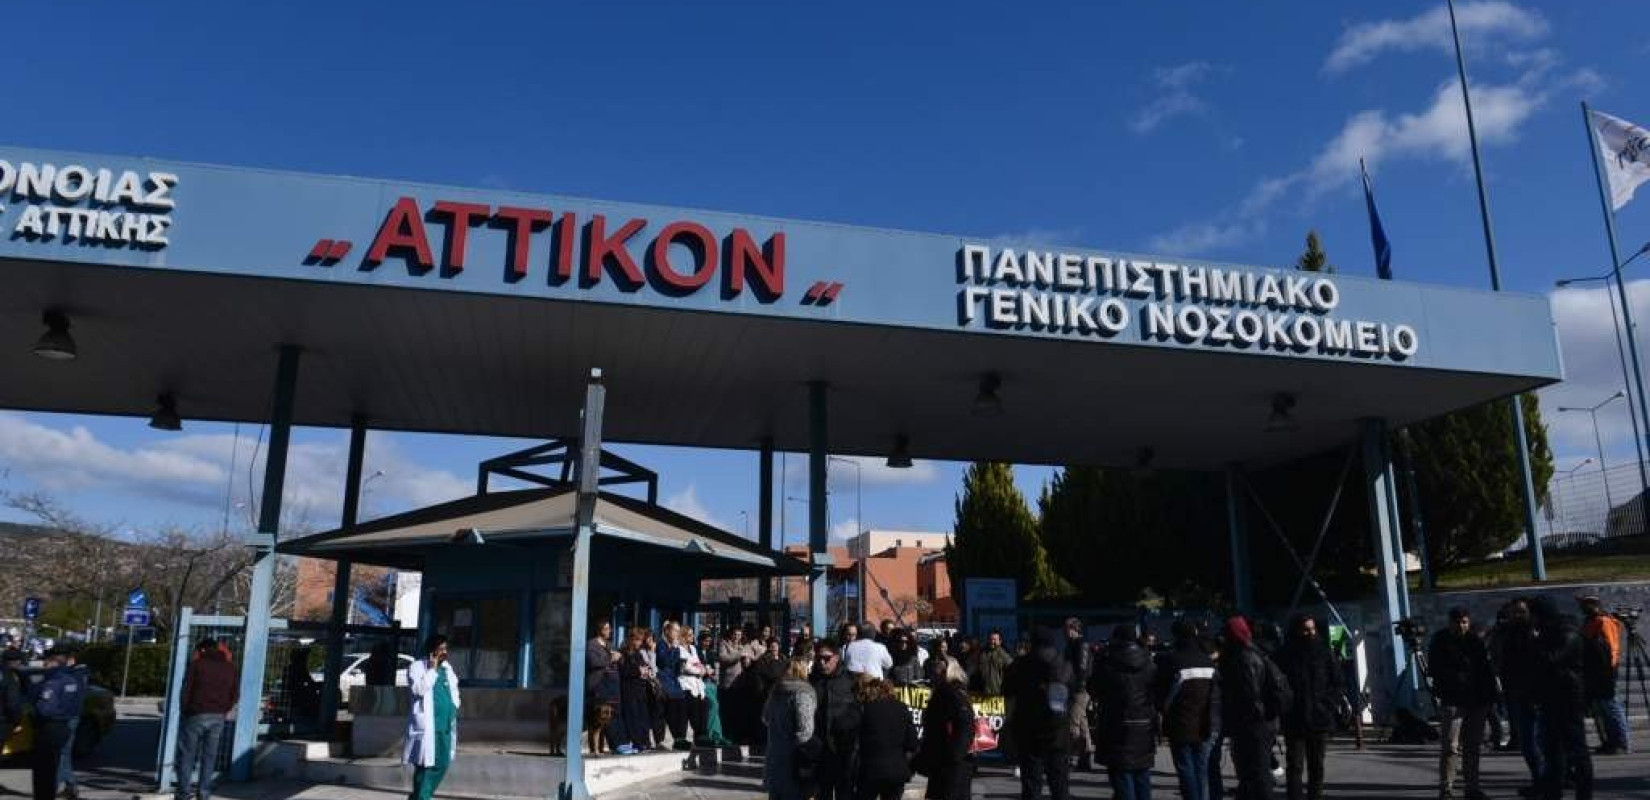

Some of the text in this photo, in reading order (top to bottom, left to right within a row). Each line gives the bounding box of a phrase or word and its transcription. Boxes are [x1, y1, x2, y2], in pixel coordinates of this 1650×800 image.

[14, 204, 172, 247] ΑΤΤΙΚΗΣ
[957, 243, 1341, 312] ΠΑΝΕΠΙΣΤΗΜΙΑΚΟ
[959, 286, 1418, 359] ΓΕΝΙΚΟ ΝΟΣΟΚΟΜΕΙΟ
